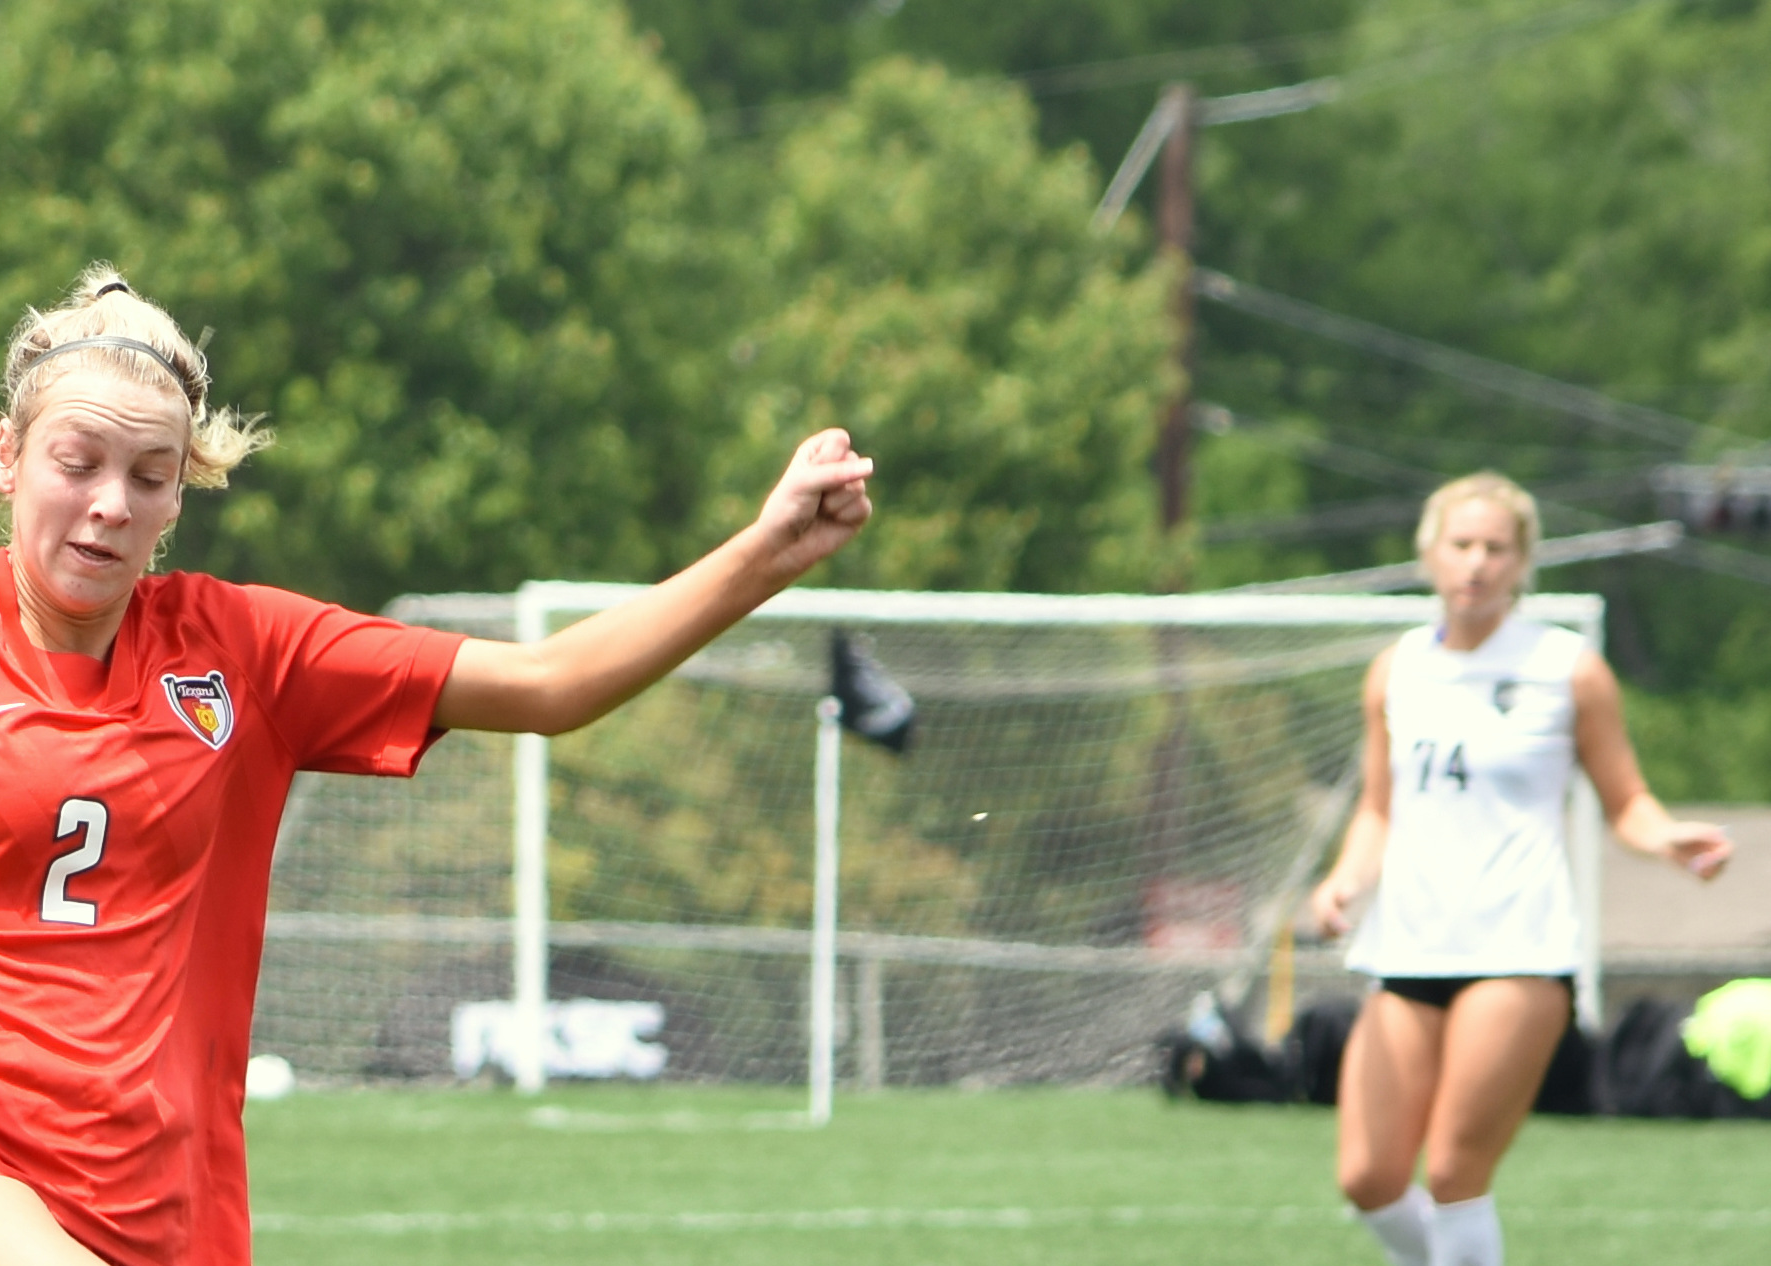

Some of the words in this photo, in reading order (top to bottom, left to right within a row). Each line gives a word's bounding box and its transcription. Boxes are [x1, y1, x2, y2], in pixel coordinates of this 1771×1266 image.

[176, 683, 215, 699] Texans
[1412, 738, 1470, 792] 74
[39, 796, 109, 926] 2
